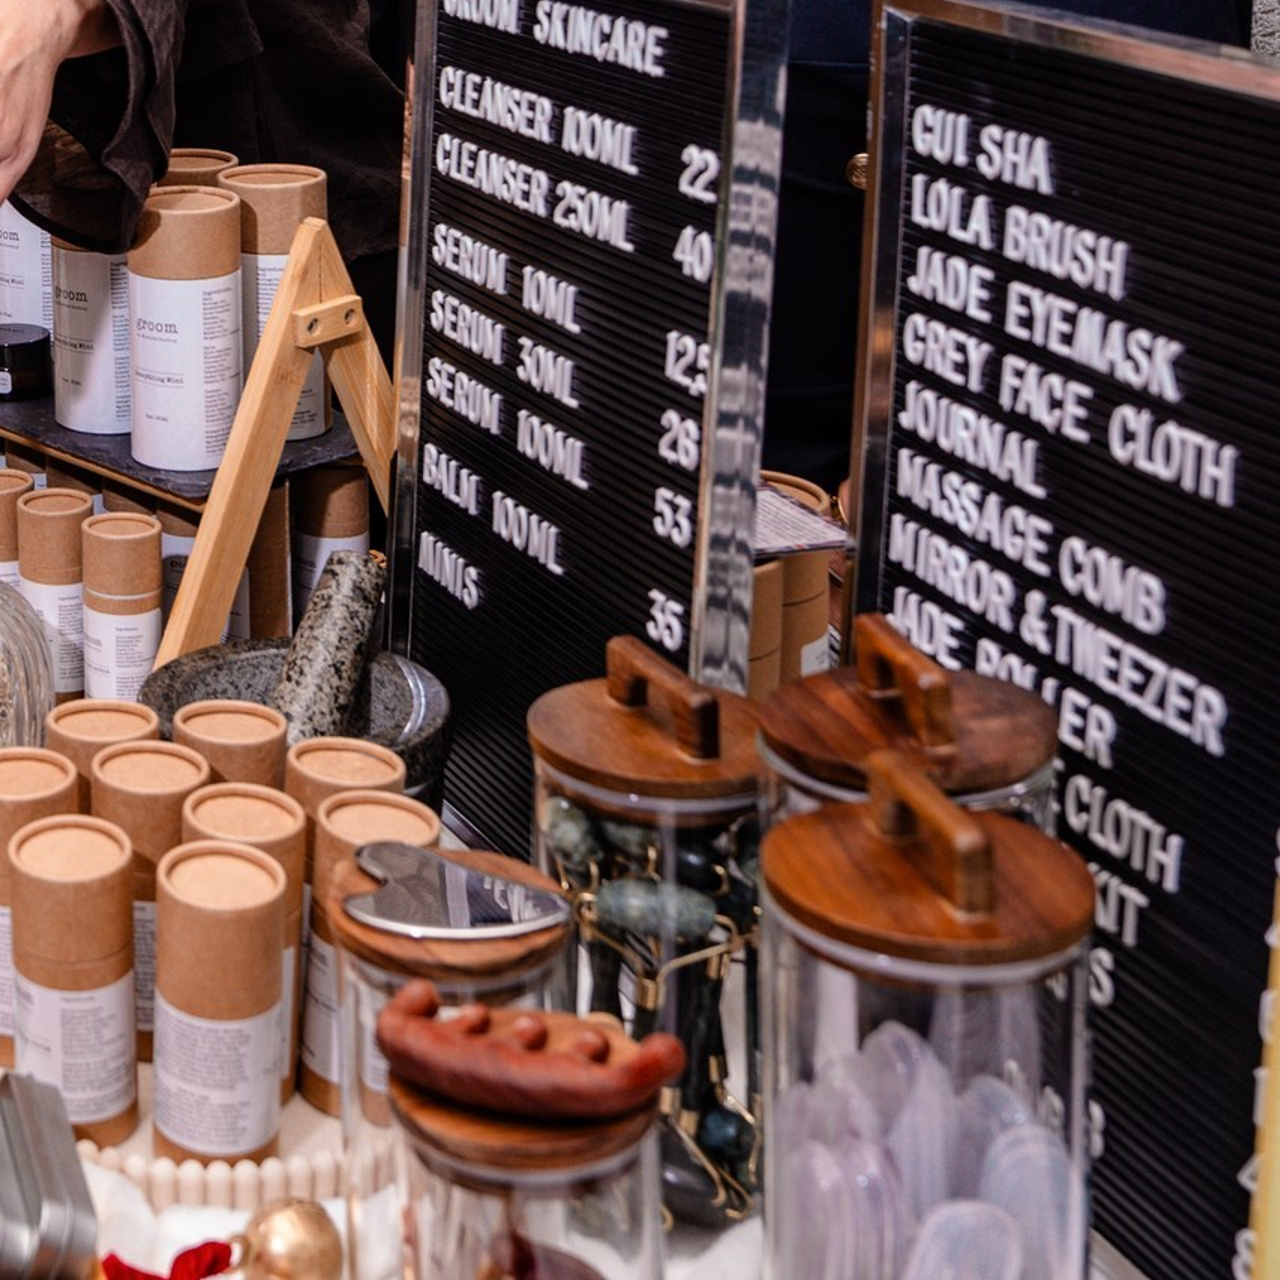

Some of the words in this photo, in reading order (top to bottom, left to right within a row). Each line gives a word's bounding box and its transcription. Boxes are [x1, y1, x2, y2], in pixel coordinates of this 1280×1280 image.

[439, 65, 555, 144] CLEANSER
[560, 105, 640, 176] 100ML
[677, 144, 720, 203] 22
[911, 104, 970, 168] GUI
[975, 124, 1056, 196] SHA
[436, 133, 550, 218] CLEANSER
[552, 180, 635, 253] 250ML
[672, 225, 714, 284] 40
[911, 173, 995, 251] LOLA
[1003, 205, 1130, 302] BRUSH
[136, 318, 178, 334] groom
[431, 223, 509, 296] SERUM
[521, 264, 582, 335] 10ML
[907, 246, 996, 323] JADE
[1004, 280, 1186, 404] EYEMASK
[429, 289, 507, 366] SERUM
[516, 336, 580, 410] 30ML
[658, 409, 701, 472] 26
[898, 379, 1049, 500] JOURNAL
[902, 312, 996, 394] GREY
[998, 354, 1095, 444] FACE
[1108, 403, 1241, 509] CLOTH
[426, 356, 504, 436] SERUM
[516, 408, 589, 490] 100ML
[652, 486, 693, 549] 53
[418, 531, 482, 611] MINIS
[422, 442, 483, 517] BALM
[491, 489, 566, 576] 100ML
[645, 588, 686, 652] 35
[896, 447, 1054, 578] MASSAGE
[1059, 535, 1168, 636] COMB
[885, 585, 966, 671] JADE
[887, 512, 1017, 633] MIRROR
[1020, 589, 1052, 655] &
[1051, 603, 1230, 758] TWEEZER
[1064, 773, 1186, 894] CLOTH
